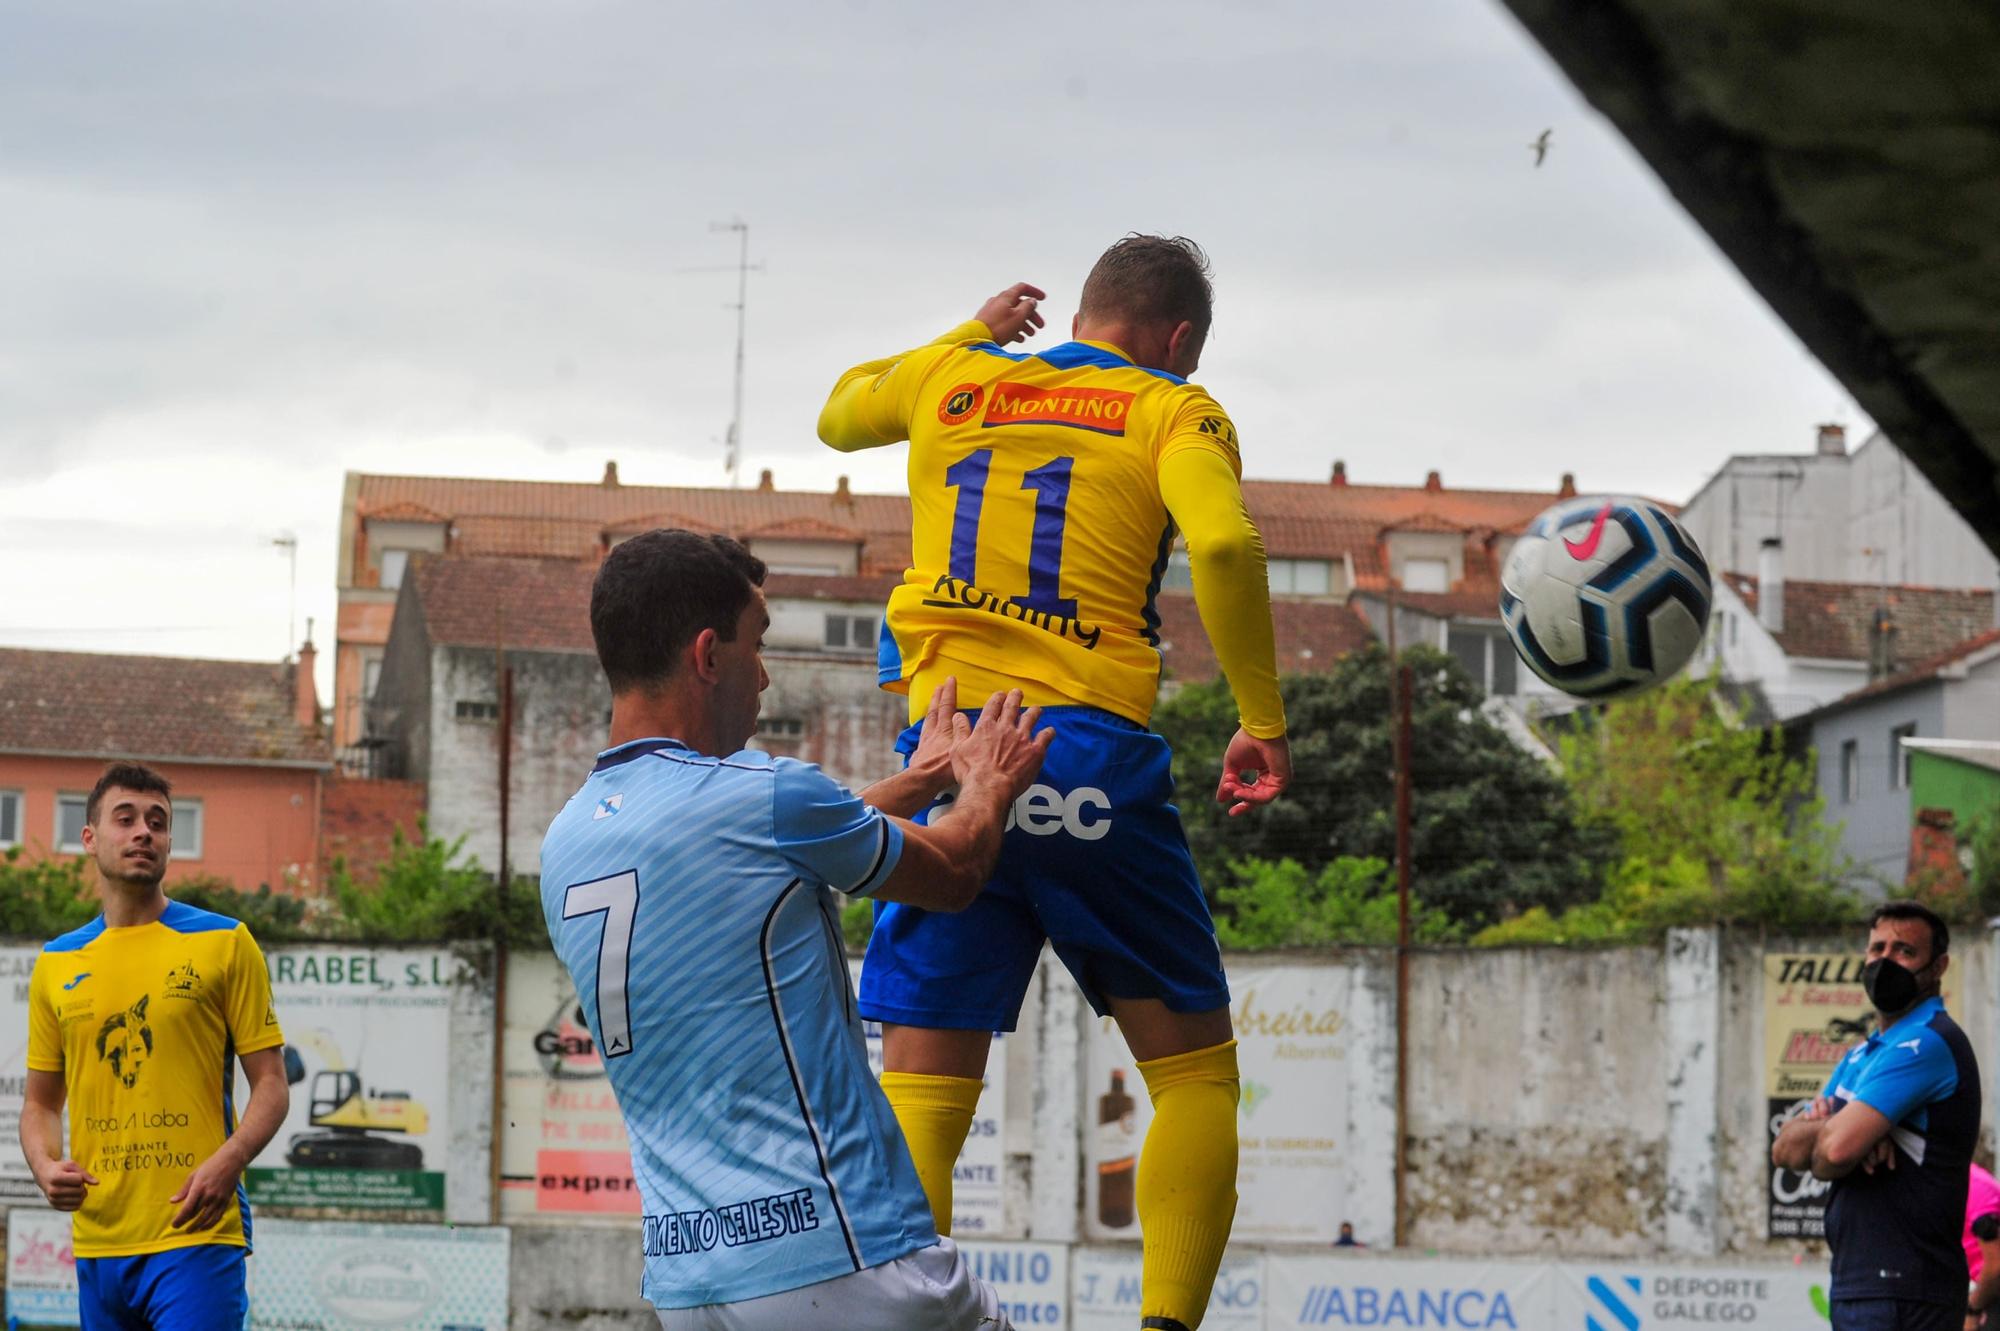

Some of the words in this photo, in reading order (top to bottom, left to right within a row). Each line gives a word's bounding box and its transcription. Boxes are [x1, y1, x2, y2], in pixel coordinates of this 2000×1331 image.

[992, 393, 1125, 420] MONTIÑO
[945, 448, 1078, 620] 11
[562, 868, 641, 1060] 7
[143, 1107, 189, 1128] Loba
[717, 1187, 819, 1248] CELESTE
[1653, 1277, 1769, 1300] DEPORTE
[1653, 1301, 1757, 1323] GALEGO
